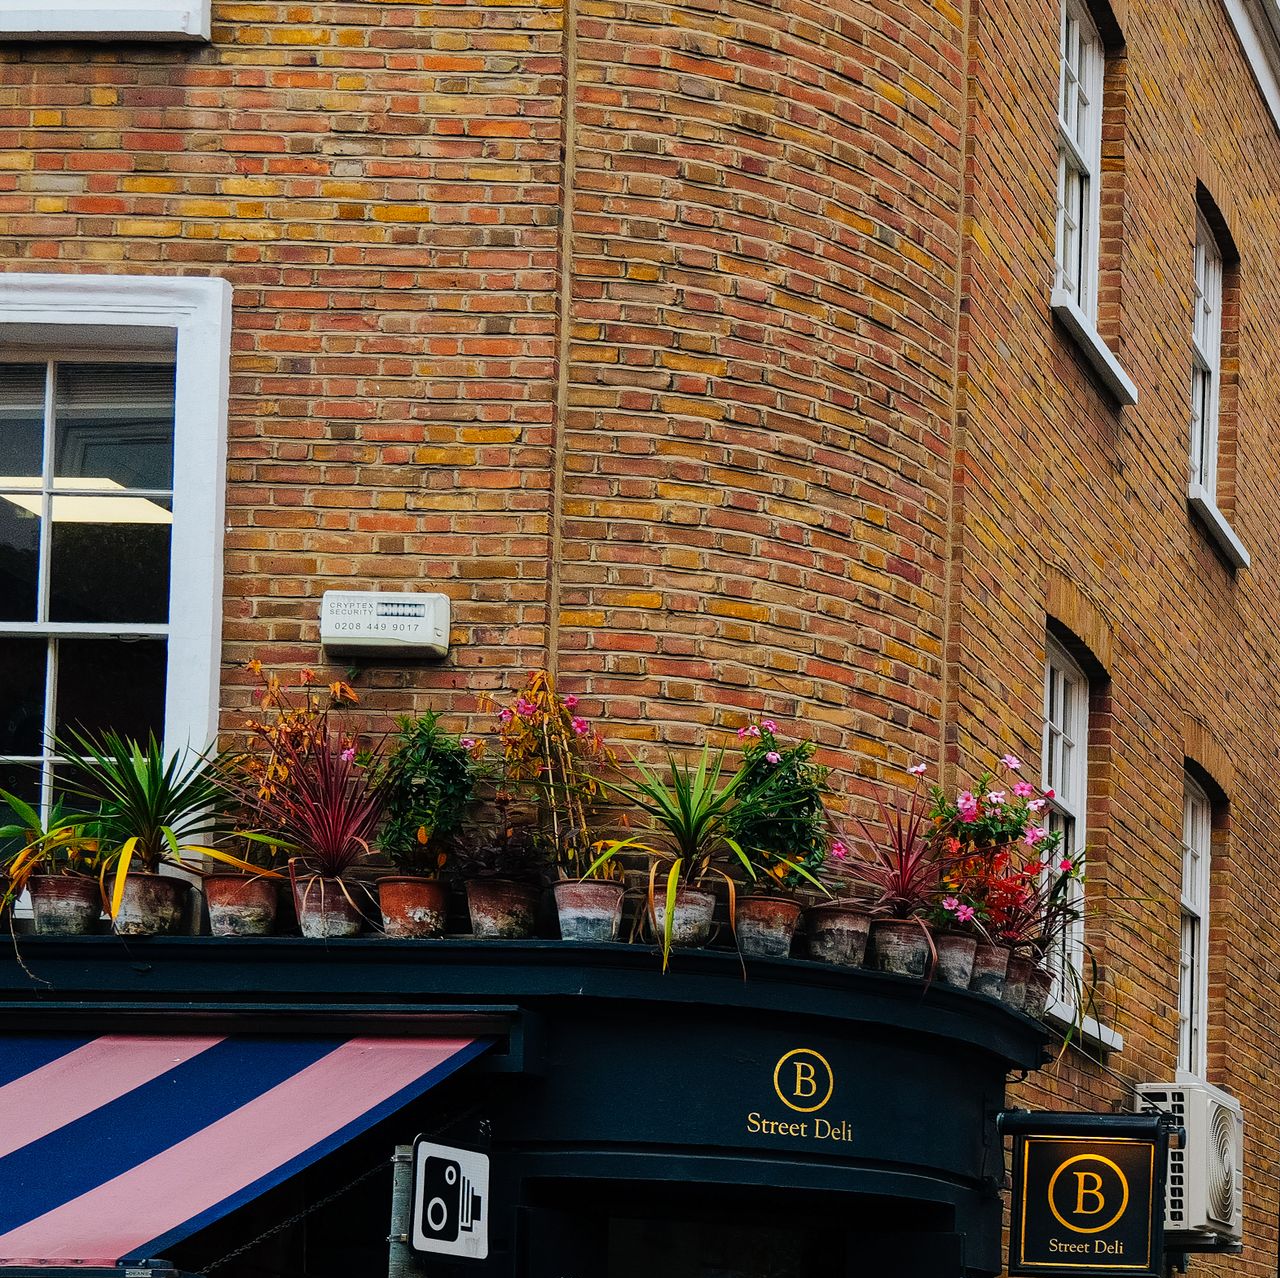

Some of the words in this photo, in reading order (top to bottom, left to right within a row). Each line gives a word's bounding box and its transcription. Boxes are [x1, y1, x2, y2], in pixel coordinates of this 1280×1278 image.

[334, 622, 361, 630] 0208
[392, 624, 420, 632] 9017
[793, 1061, 817, 1097] B
[746, 1111, 808, 1137] Street
[813, 1118, 853, 1142] Deli
[1072, 1171, 1105, 1214] B
[1048, 1238, 1090, 1253] Street
[1094, 1239, 1124, 1254] Deli
